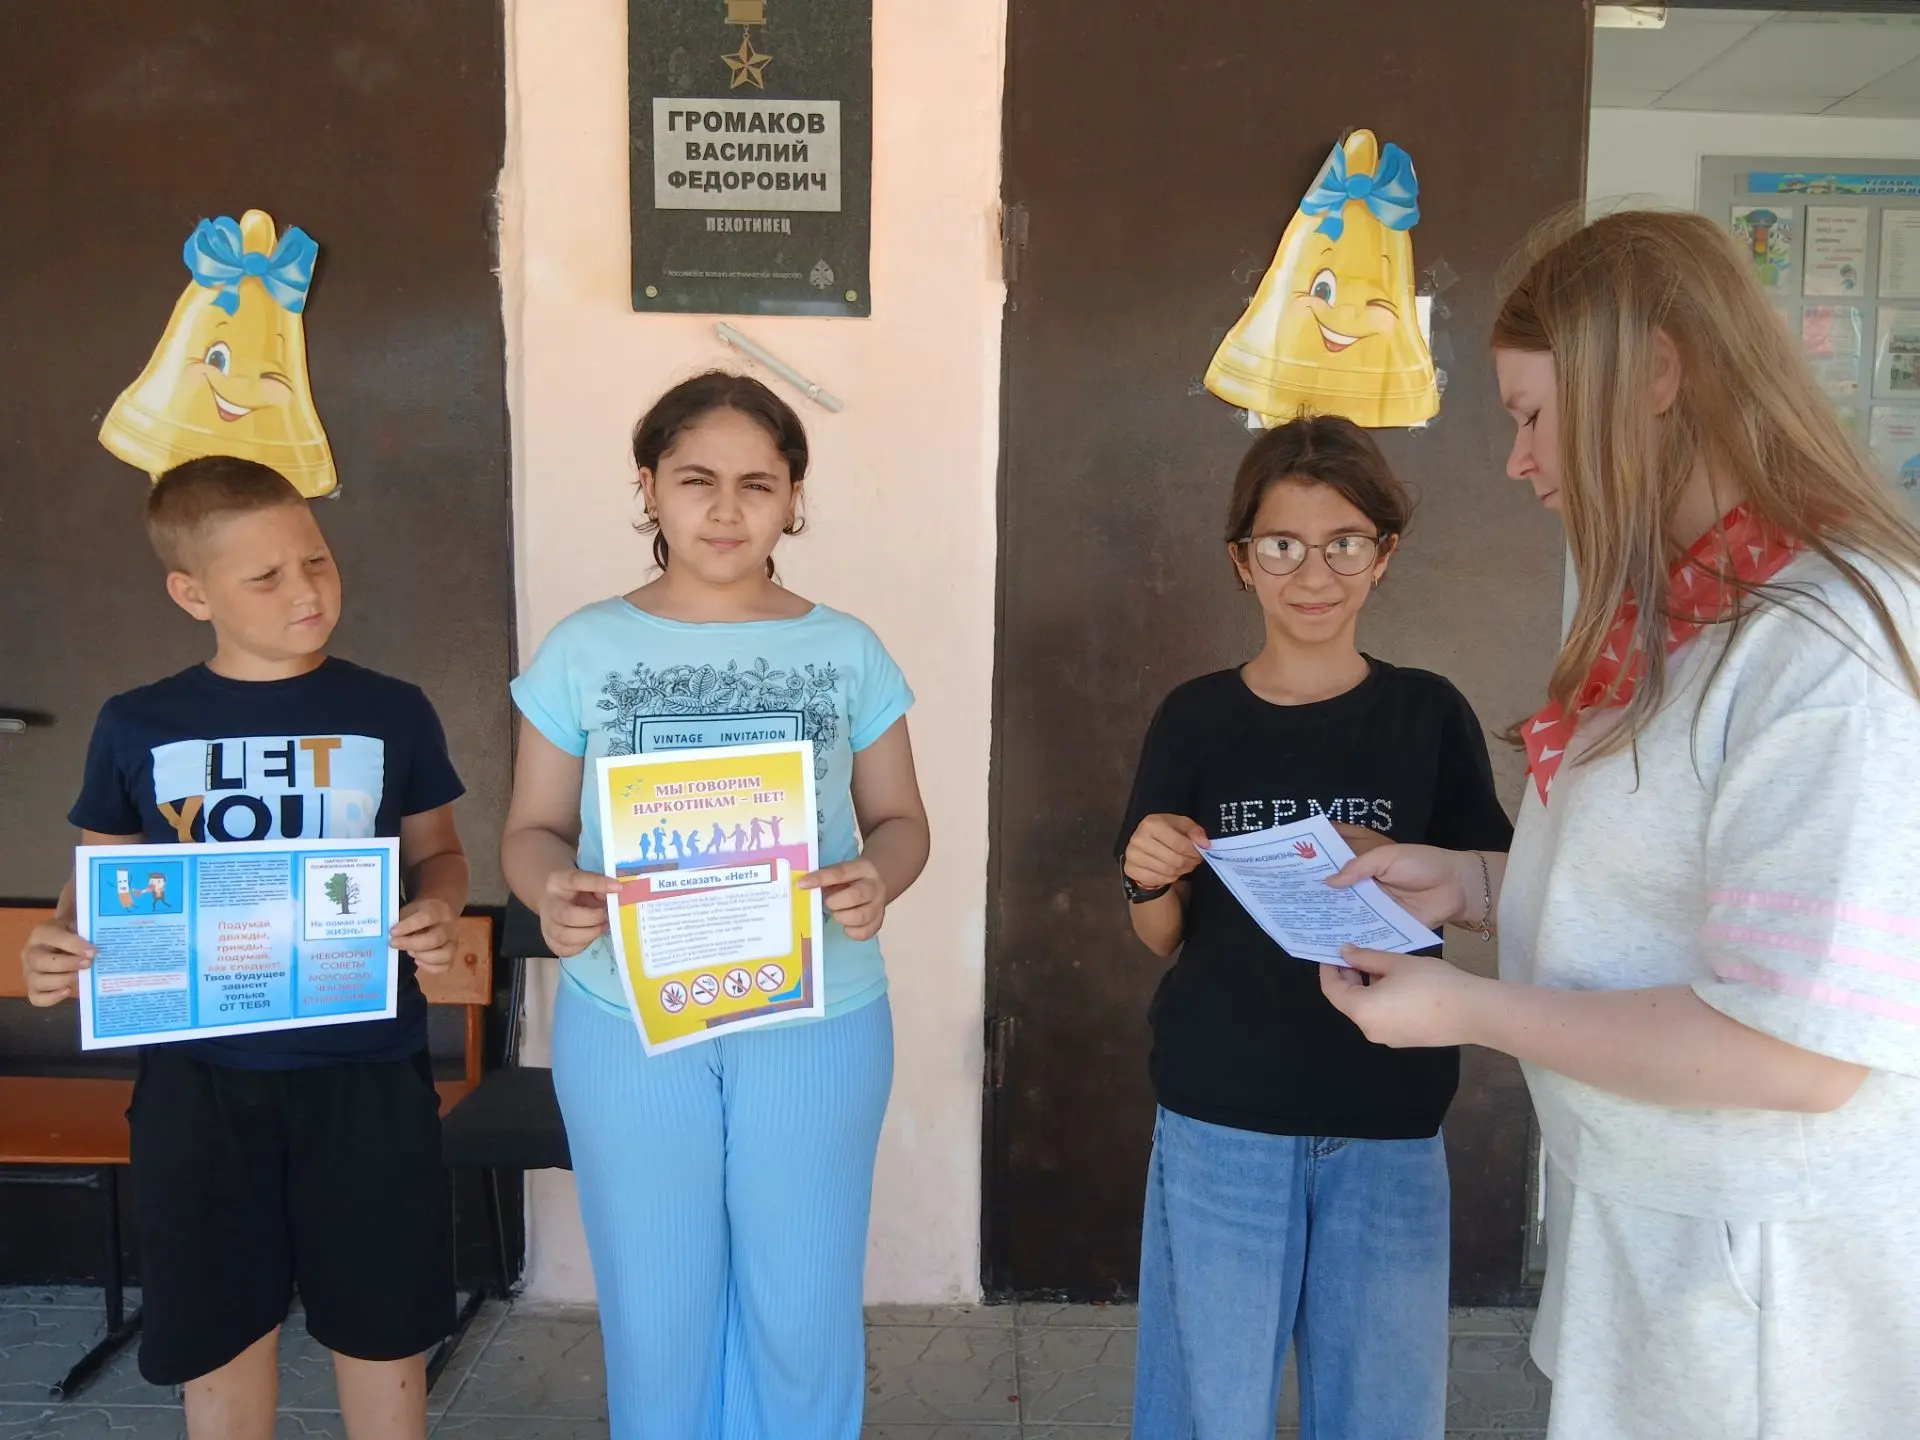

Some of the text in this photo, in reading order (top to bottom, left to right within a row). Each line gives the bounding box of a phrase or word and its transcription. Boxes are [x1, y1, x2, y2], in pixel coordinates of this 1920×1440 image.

[668, 110, 826, 134] ГРОМАКОВ
[686, 140, 808, 163] ВАСИЛИЙ
[667, 171, 827, 193] ФЕДОРОВИЧ
[706, 217, 792, 235] ПЕХОТИНЕЦ
[653, 730, 786, 745] VINTAGE INVITATION
[206, 737, 342, 791] LET
[656, 776, 761, 797] МЫ ГОВОРИМ
[633, 795, 735, 815] НАРКОТИКАМ
[753, 791, 784, 804] НЕТ!
[157, 789, 374, 843] YOUR
[658, 870, 759, 889] Как сказать «Нет!»
[204, 971, 286, 981] Твое будущее
[221, 982, 268, 991] зависит
[225, 992, 265, 1001] только
[219, 1000, 271, 1012] ОТ ТЕБЯ
